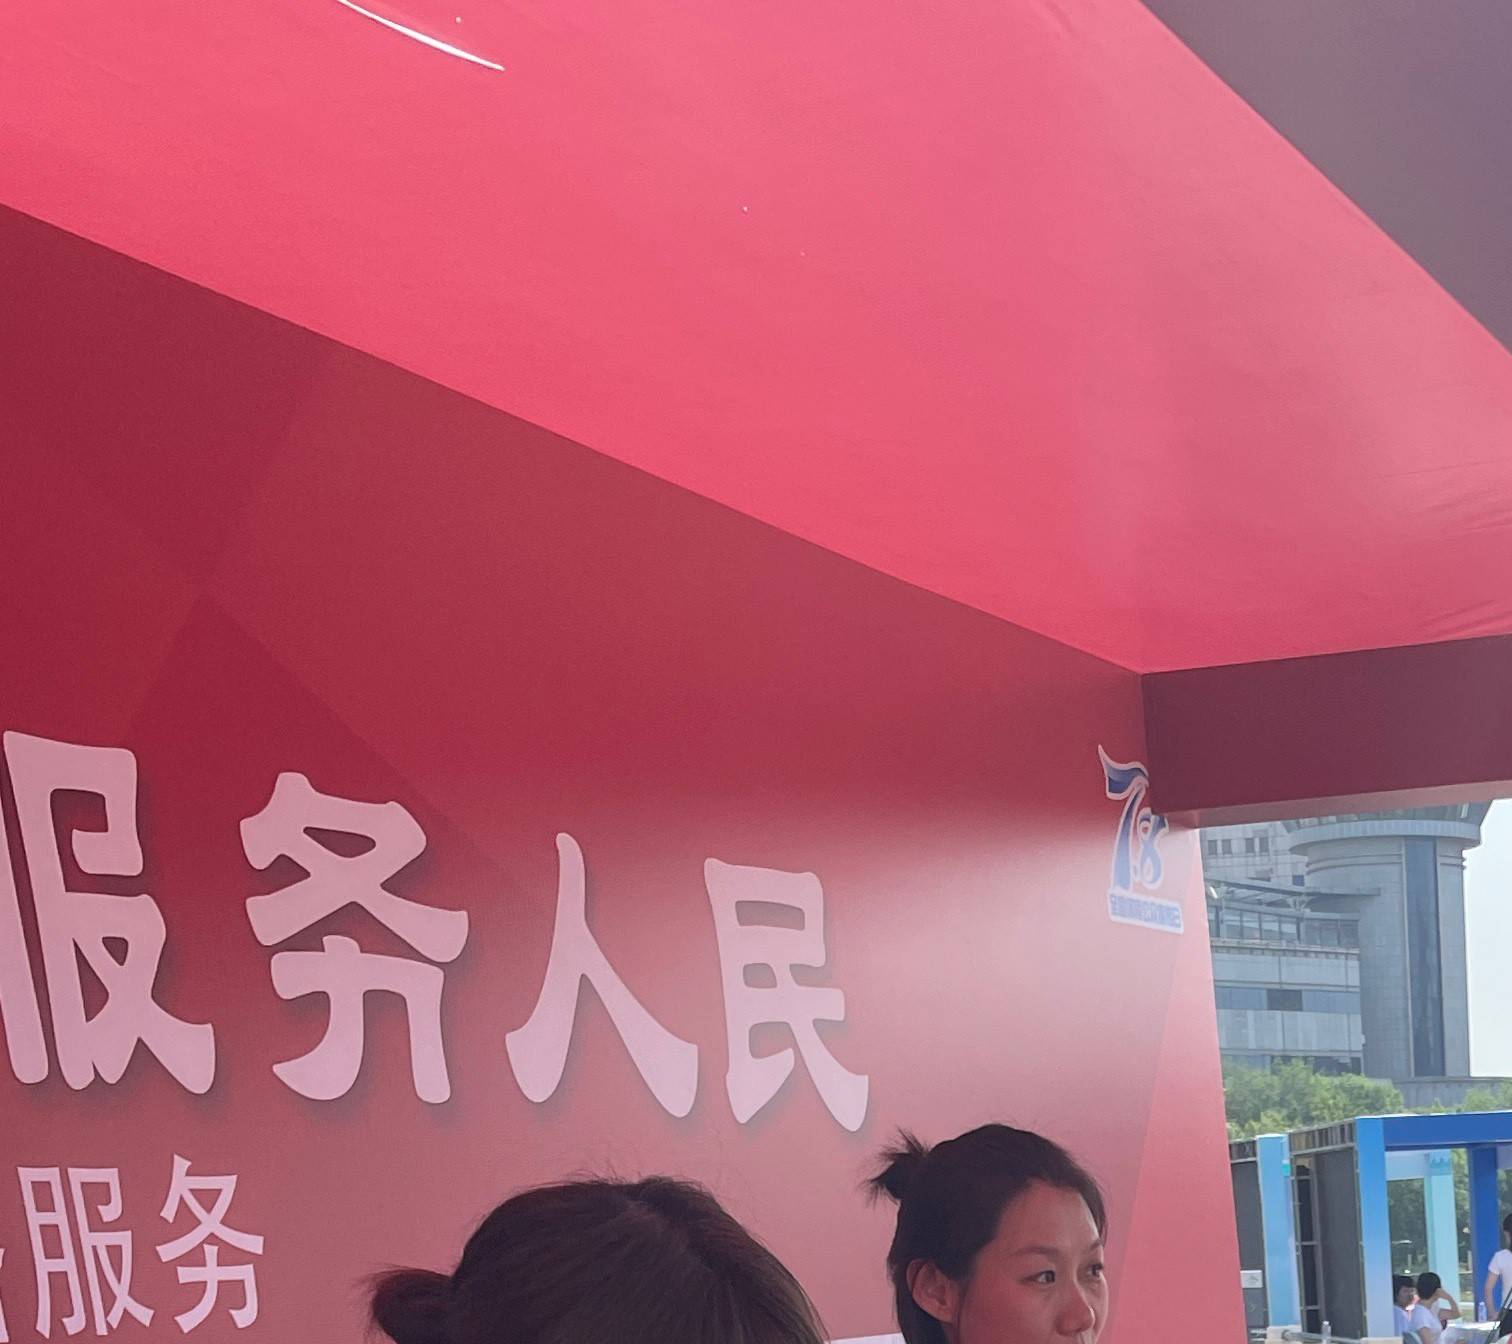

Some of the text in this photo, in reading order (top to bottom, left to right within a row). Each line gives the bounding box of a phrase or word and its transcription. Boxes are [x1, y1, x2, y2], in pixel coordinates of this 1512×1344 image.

[0, 730, 869, 1132] 服务人民
[0, 1153, 264, 1343] 服务
